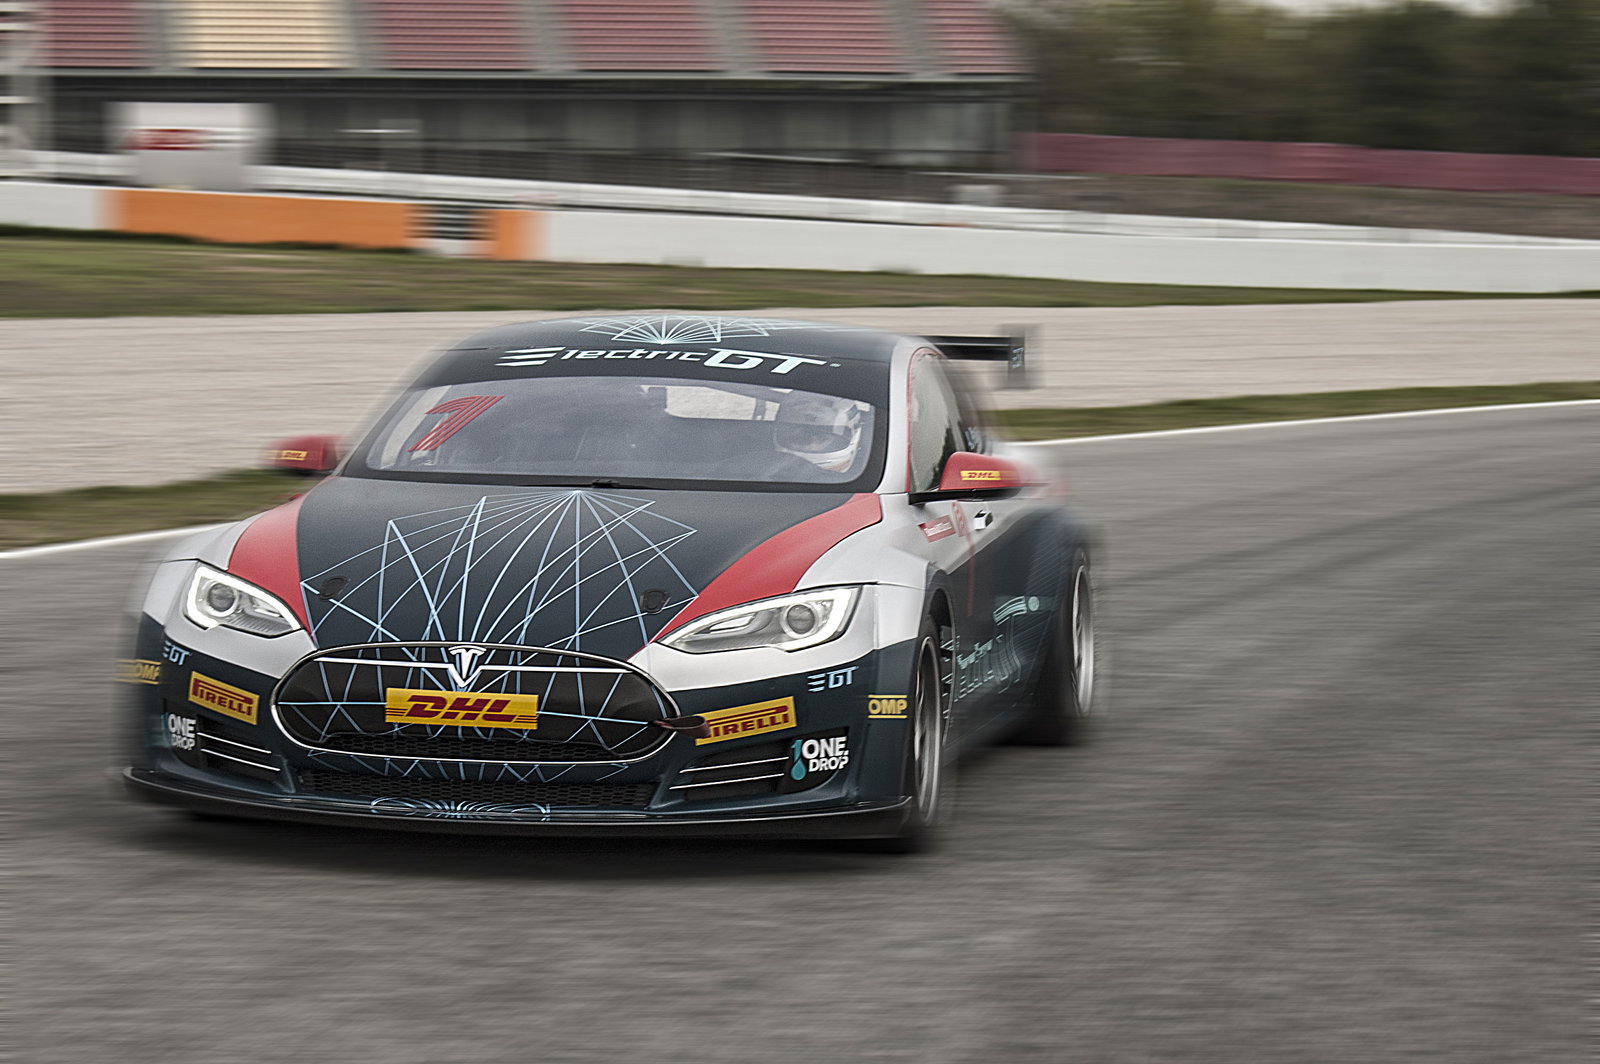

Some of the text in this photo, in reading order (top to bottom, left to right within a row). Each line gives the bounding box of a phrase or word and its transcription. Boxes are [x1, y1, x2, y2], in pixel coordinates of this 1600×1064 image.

[967, 471, 997, 479] DHL
[192, 677, 254, 716] PIRELLI
[867, 698, 908, 716] OMP
[405, 694, 517, 723] DHL
[167, 713, 197, 739] ONE
[171, 733, 196, 752] DROP
